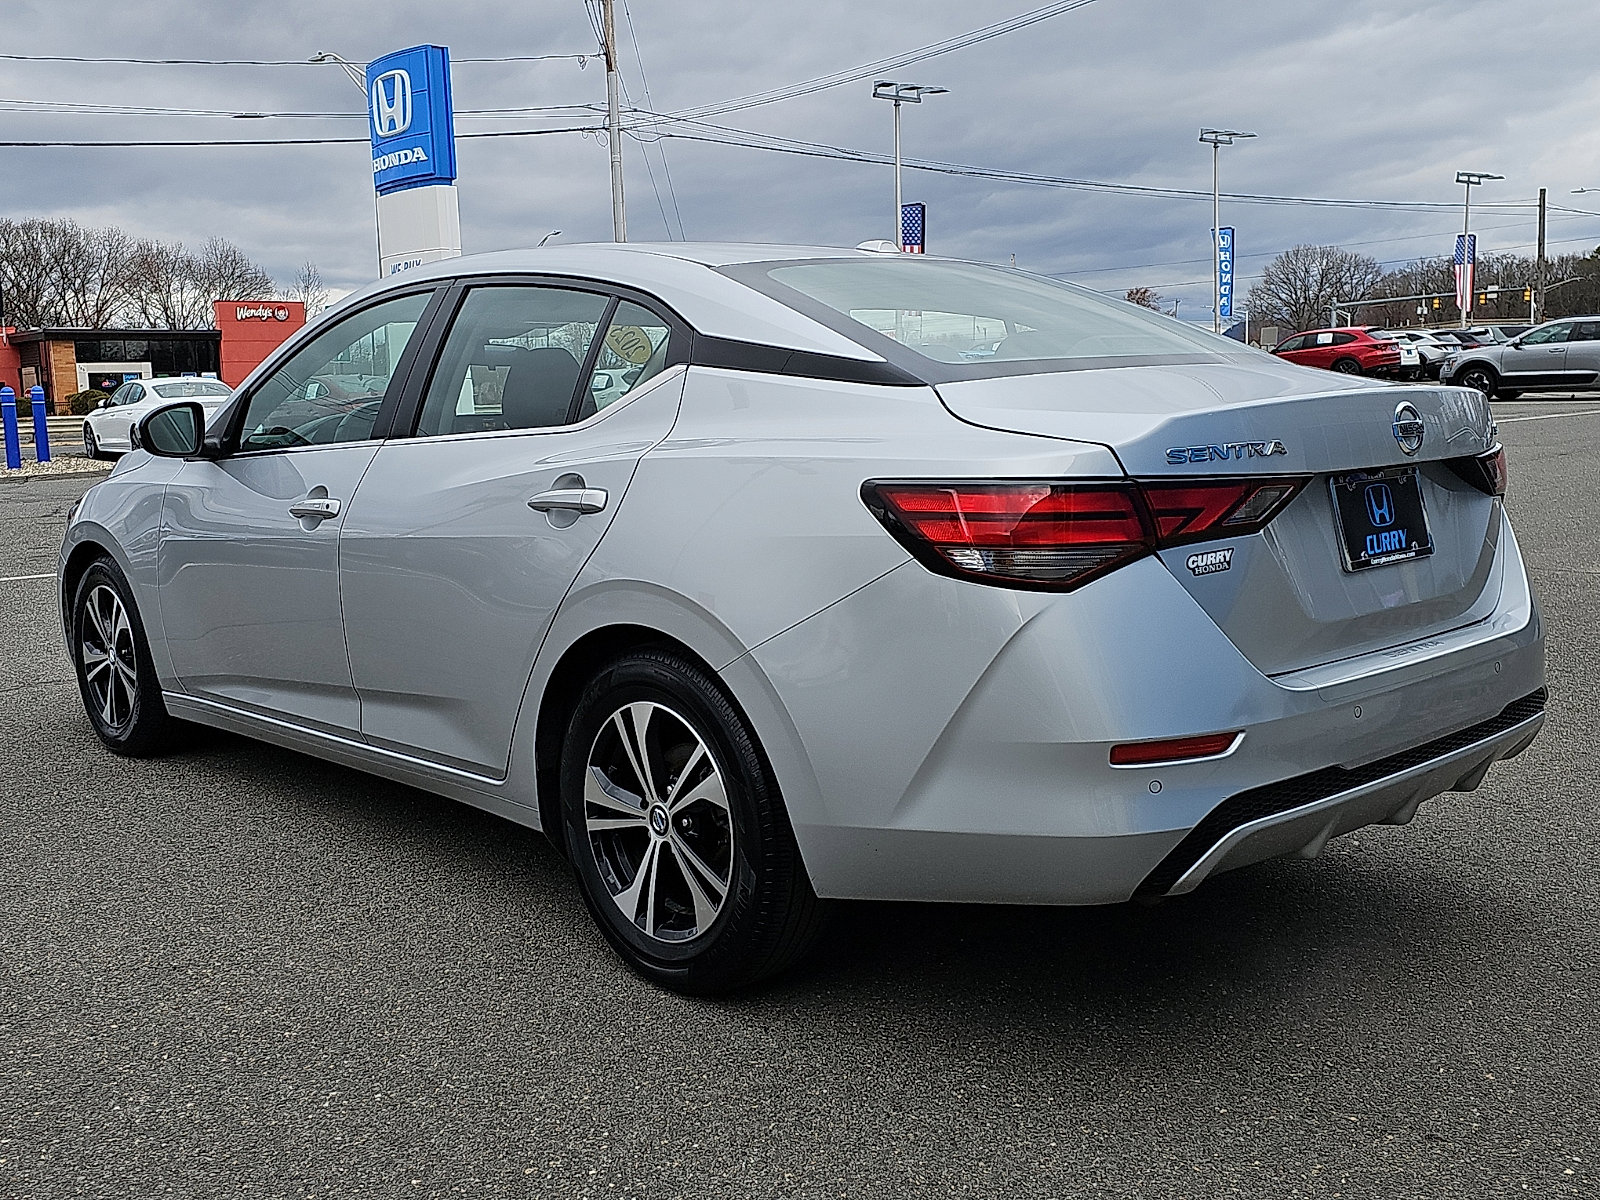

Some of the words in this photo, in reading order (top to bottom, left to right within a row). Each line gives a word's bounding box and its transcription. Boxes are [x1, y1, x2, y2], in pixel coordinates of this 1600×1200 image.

[373, 147, 428, 173] HONDA
[236, 304, 273, 321] Wendy's
[1166, 439, 1288, 464] SENTRA
[1366, 529, 1408, 555] CURRY
[1188, 549, 1233, 568] CURRY
[1194, 562, 1230, 575] HONDA
[1382, 640, 1445, 657] SENTRA
